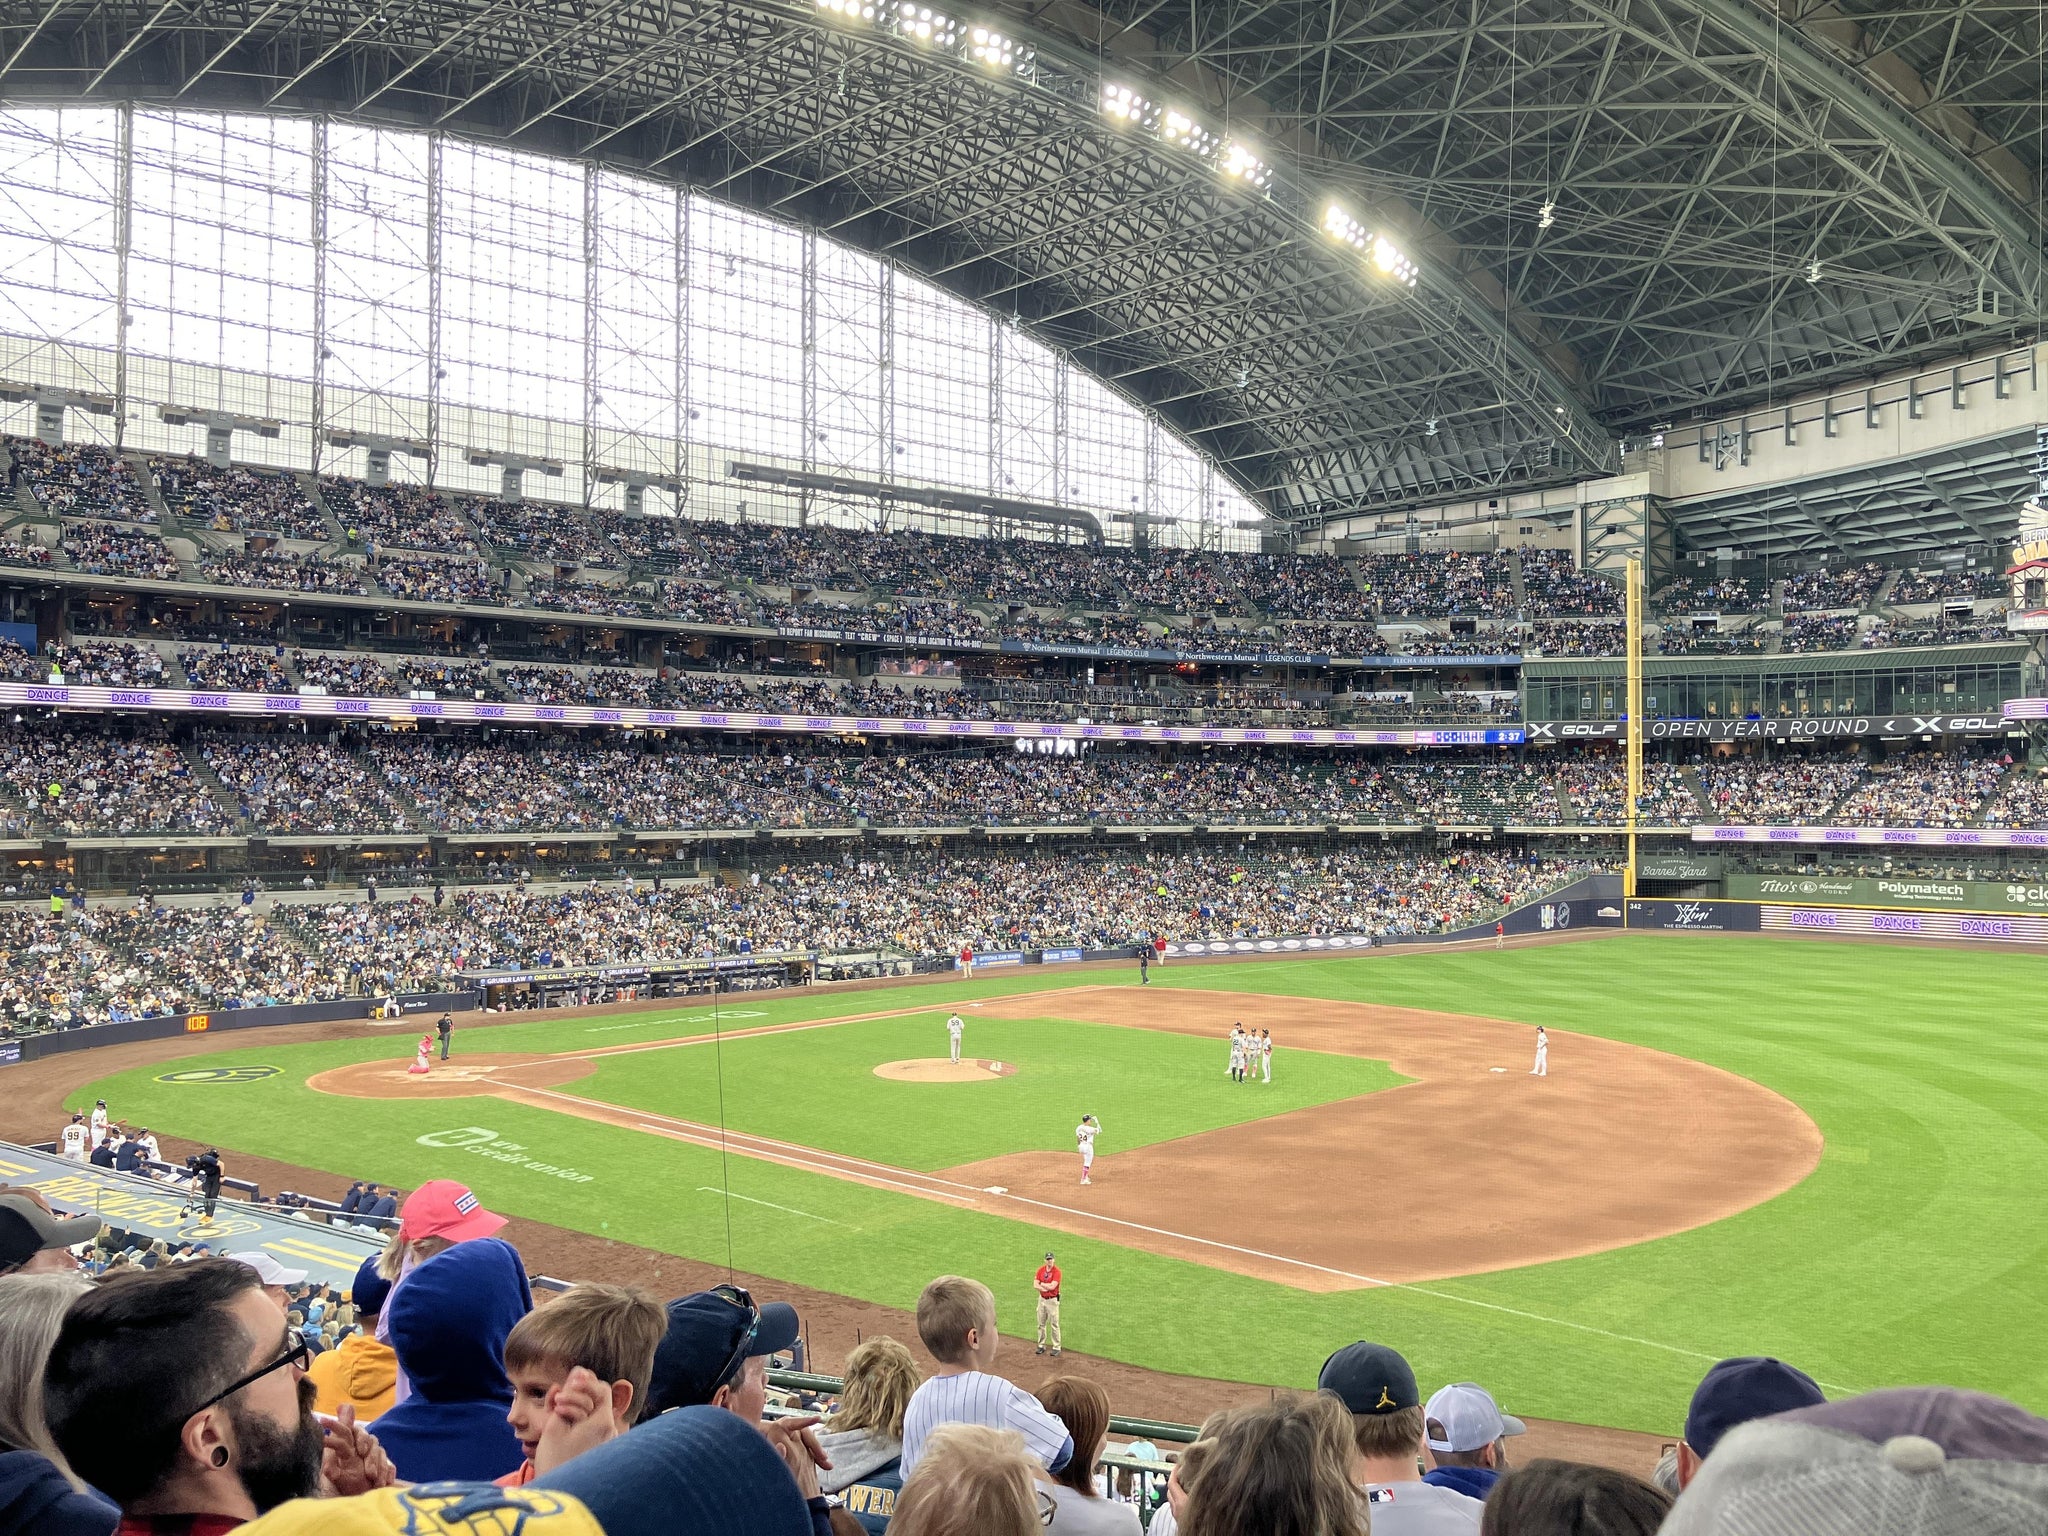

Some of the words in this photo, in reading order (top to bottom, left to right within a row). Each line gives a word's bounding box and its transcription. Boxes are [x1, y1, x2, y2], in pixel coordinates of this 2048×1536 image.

[787, 628, 803, 637] REPORT
[845, 631, 855, 640] TEXT
[1031, 643, 1075, 654] Northwestern
[1077, 646, 1100, 655] Mutual
[1107, 648, 1133, 657] LEGENDS
[1133, 650, 1149, 658] CLUB
[1186, 652, 1232, 661] Northwestern
[1234, 654, 1259, 662] Mutual
[1265, 655, 1293, 663] LEGENDS
[1294, 655, 1311, 663] CLUB
[1436, 657, 1465, 665] TEQUILA
[1466, 656, 1485, 664] PATIO
[26, 688, 68, 702] DANCE
[110, 692, 151, 704] DANCE
[189, 695, 228, 707] DANCE
[265, 699, 300, 710] DANCE
[335, 701, 368, 712] DANCE
[410, 704, 442, 714] DANCE
[475, 707, 504, 717] DANCE
[535, 708, 564, 719] DANCE
[593, 711, 620, 721] DANCE
[647, 713, 675, 723] DANCE
[701, 716, 727, 724] DANCE
[758, 717, 781, 727] DANCE
[807, 719, 829, 728] DANCE
[856, 720, 879, 729] DANCE
[904, 722, 925, 731] DANCE
[949, 723, 970, 732] DANCE
[1652, 722, 1711, 737] OPEN
[1723, 722, 1778, 736] YEAR
[1790, 719, 1869, 735] ROUND
[1912, 717, 1943, 733] X
[1950, 718, 2015, 730] GOLF
[993, 724, 1014, 734] DANCE
[1201, 730, 1222, 738] DANCE
[1528, 723, 1555, 738] X
[1562, 725, 1618, 735] GOLF
[1244, 731, 1265, 740] DANCE
[1376, 733, 1396, 741] DANCE
[1498, 732, 1521, 741] 2:37
[1714, 829, 1744, 839] DANCE
[1769, 830, 1798, 839] DANCE
[1825, 831, 1855, 841] DANCE
[1883, 832, 1915, 841] DANCE
[1946, 833, 1979, 843] DANCE
[2011, 834, 2046, 844] DANCE
[1642, 865, 1677, 876] Barrel
[1679, 866, 1708, 879] Yard
[1760, 880, 1798, 893] Tito's
[1878, 881, 1964, 895] Polymatech
[1792, 914, 1834, 924] DANCE
[1873, 918, 1918, 929] DANCE
[1961, 922, 2008, 935] DANCE
[186, 1015, 208, 1031] 108
[67, 1131, 80, 1141] 99
[1078, 1133, 1088, 1142] 24
